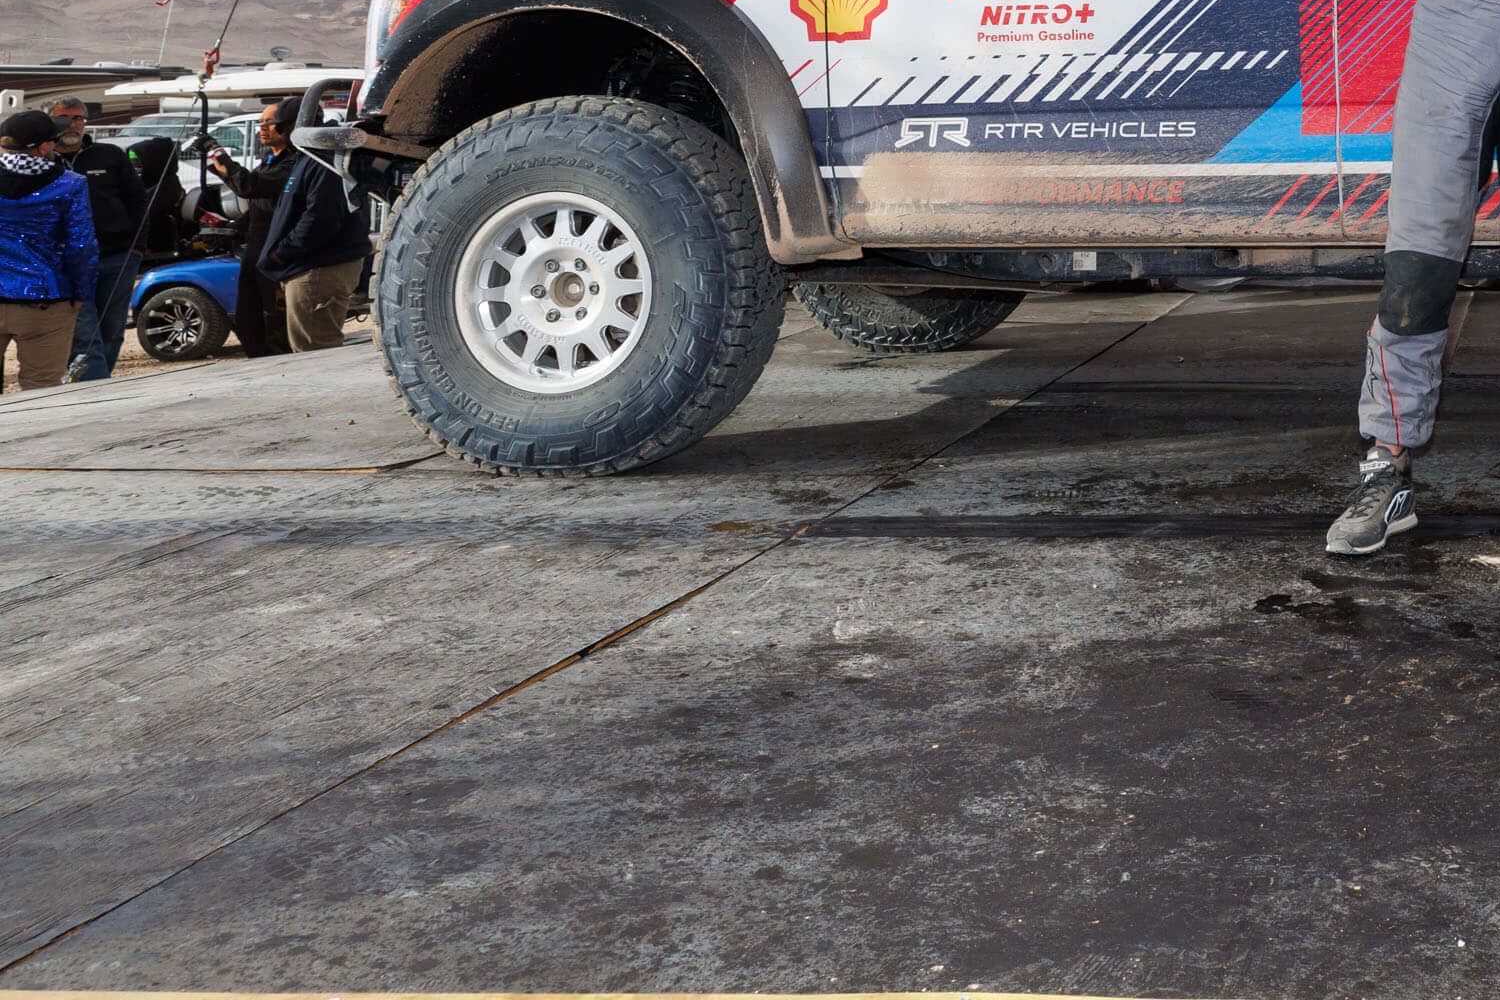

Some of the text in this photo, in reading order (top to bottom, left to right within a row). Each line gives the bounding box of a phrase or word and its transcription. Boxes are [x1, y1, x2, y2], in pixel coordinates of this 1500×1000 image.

[977, 29, 1095, 43] Premium Gasoline
[984, 121, 1198, 139] RTR VEHICLES
